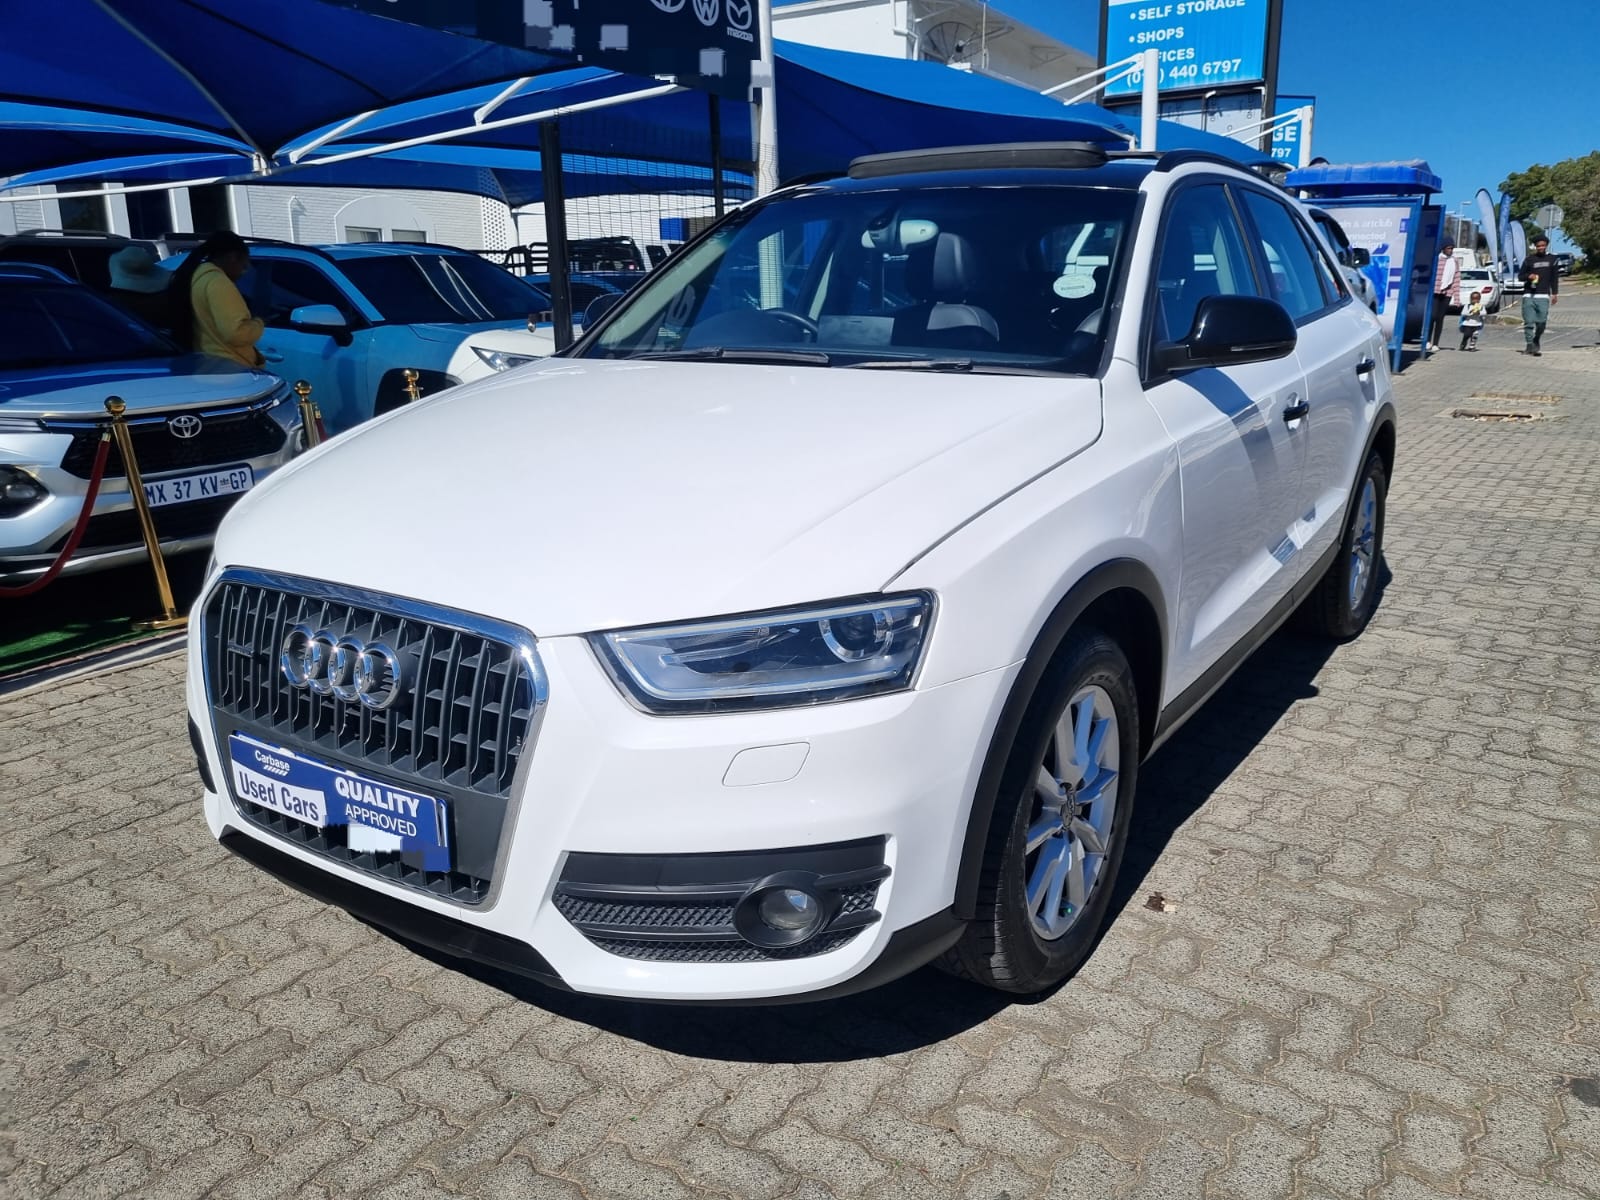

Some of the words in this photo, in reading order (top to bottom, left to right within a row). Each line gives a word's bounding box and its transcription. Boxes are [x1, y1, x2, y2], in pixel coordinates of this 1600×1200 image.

[1138, 5, 1172, 21] SELF
[1176, 0, 1246, 15] STORAGE
[1136, 27, 1184, 44] SHOPS
[1169, 64, 1198, 79] 440
[1202, 58, 1242, 75] 6797
[1272, 126, 1297, 142] GE
[1271, 147, 1291, 158] 797
[144, 484, 167, 505] MX
[172, 480, 192, 500] 37
[200, 475, 218, 496] KV
[229, 470, 247, 490] GP
[254, 749, 291, 771] Carbase
[239, 771, 275, 806] Used
[282, 786, 319, 821] Cars
[335, 776, 420, 818] QUALITY
[345, 803, 417, 837] APPROVED
